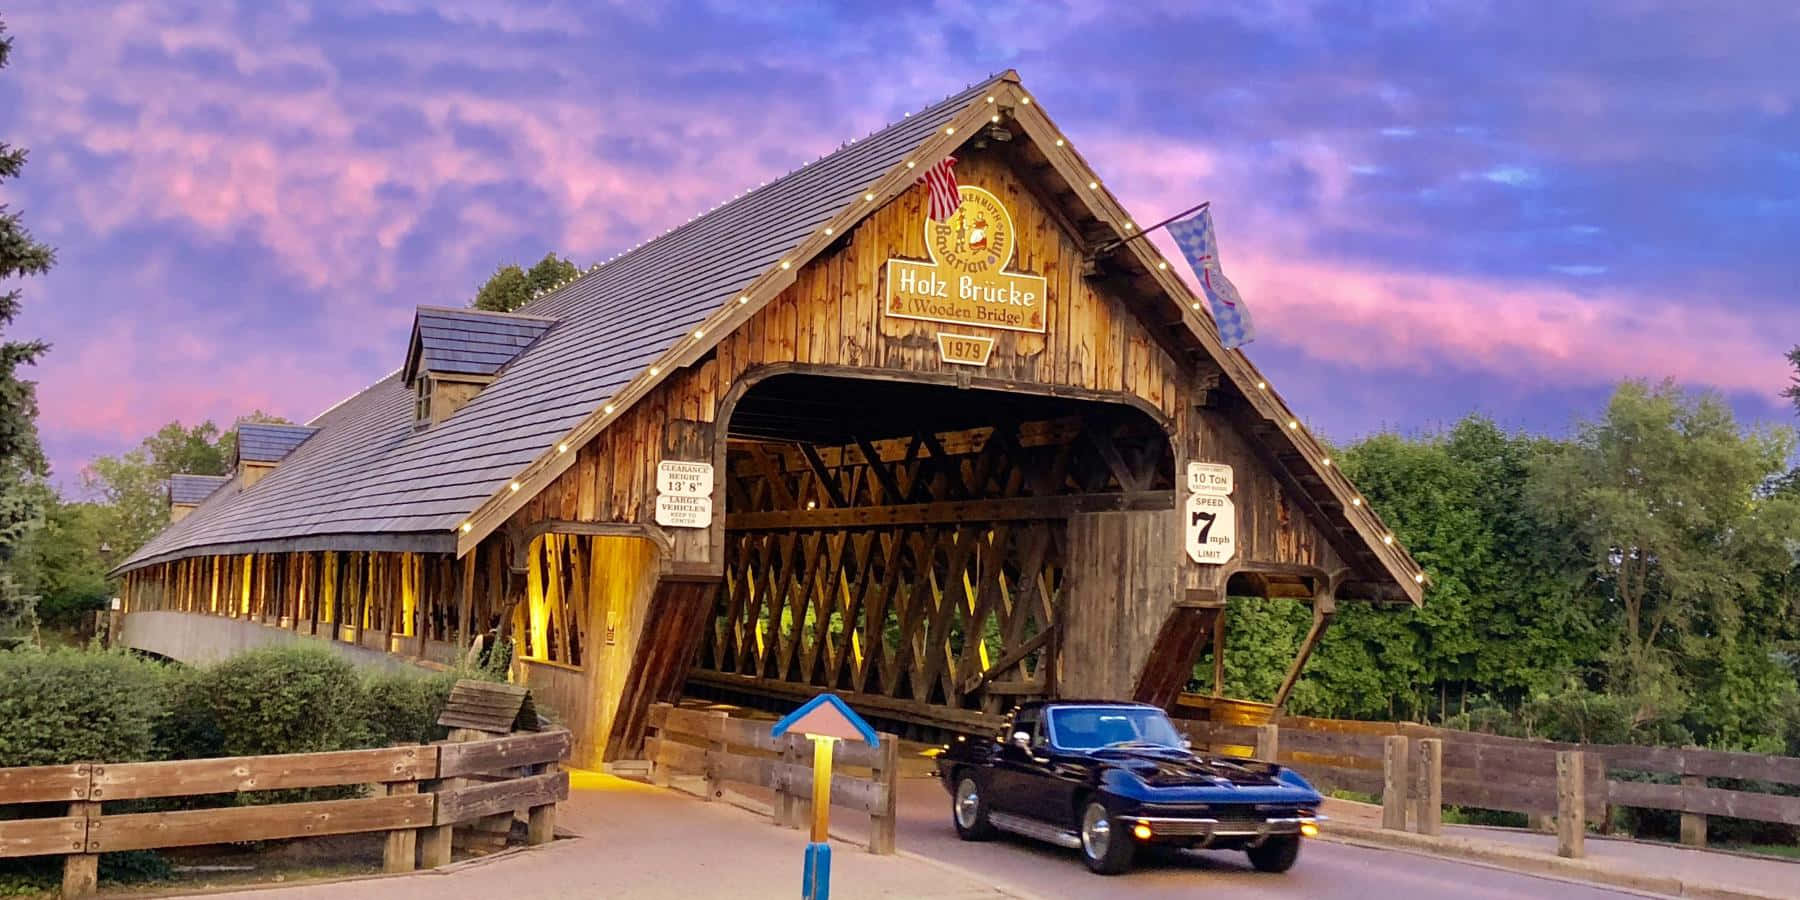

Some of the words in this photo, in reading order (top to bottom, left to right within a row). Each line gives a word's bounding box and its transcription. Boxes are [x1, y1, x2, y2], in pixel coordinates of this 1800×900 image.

[935, 225, 988, 273] Bavarian
[987, 231, 1005, 258] Inn
[900, 268, 948, 298] Holz
[959, 275, 1036, 307] Brücke
[908, 298, 972, 319] (Wooden
[976, 305, 1025, 326] Bridge)
[949, 341, 981, 359] 1979
[661, 464, 709, 474] CLEARANCE
[669, 473, 700, 481] HEIGHT
[1193, 473, 1206, 484] 10
[669, 496, 698, 505] LARGE
[1195, 497, 1224, 507] SPEED
[662, 503, 706, 513] VEHICLES
[1192, 511, 1216, 544] 7
[1210, 536, 1230, 545] mph
[1197, 550, 1221, 558] LIMIT
